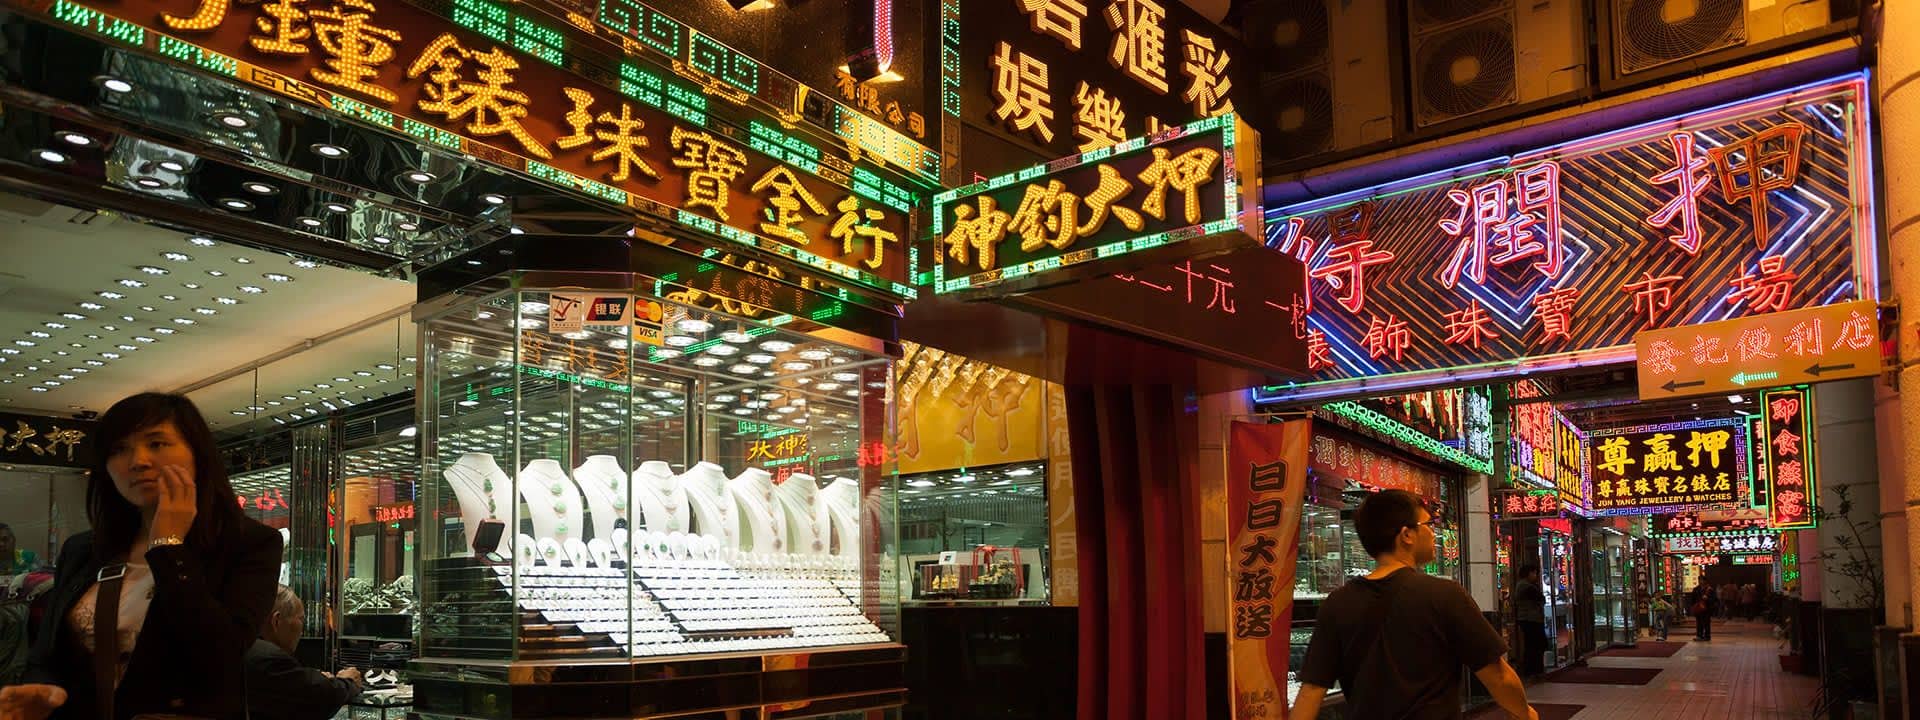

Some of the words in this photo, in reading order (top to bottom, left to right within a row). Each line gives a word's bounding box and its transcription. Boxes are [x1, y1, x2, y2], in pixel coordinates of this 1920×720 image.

[835, 71, 926, 140] 有限公司
[992, 40, 1176, 153] 娛樂
[944, 147, 1218, 271] 神釣大押
[639, 327, 658, 339] VISA
[1643, 310, 1875, 376] 發記便利店
[0, 419, 87, 462] 大押
[1596, 429, 1731, 475] 尊贏押
[1616, 498, 1636, 506] YANG
[1639, 495, 1684, 505] JEWELLERY
[1685, 495, 1692, 503] &
[1693, 493, 1732, 502] WATCHES
[1236, 460, 1288, 640] 日日大放送
